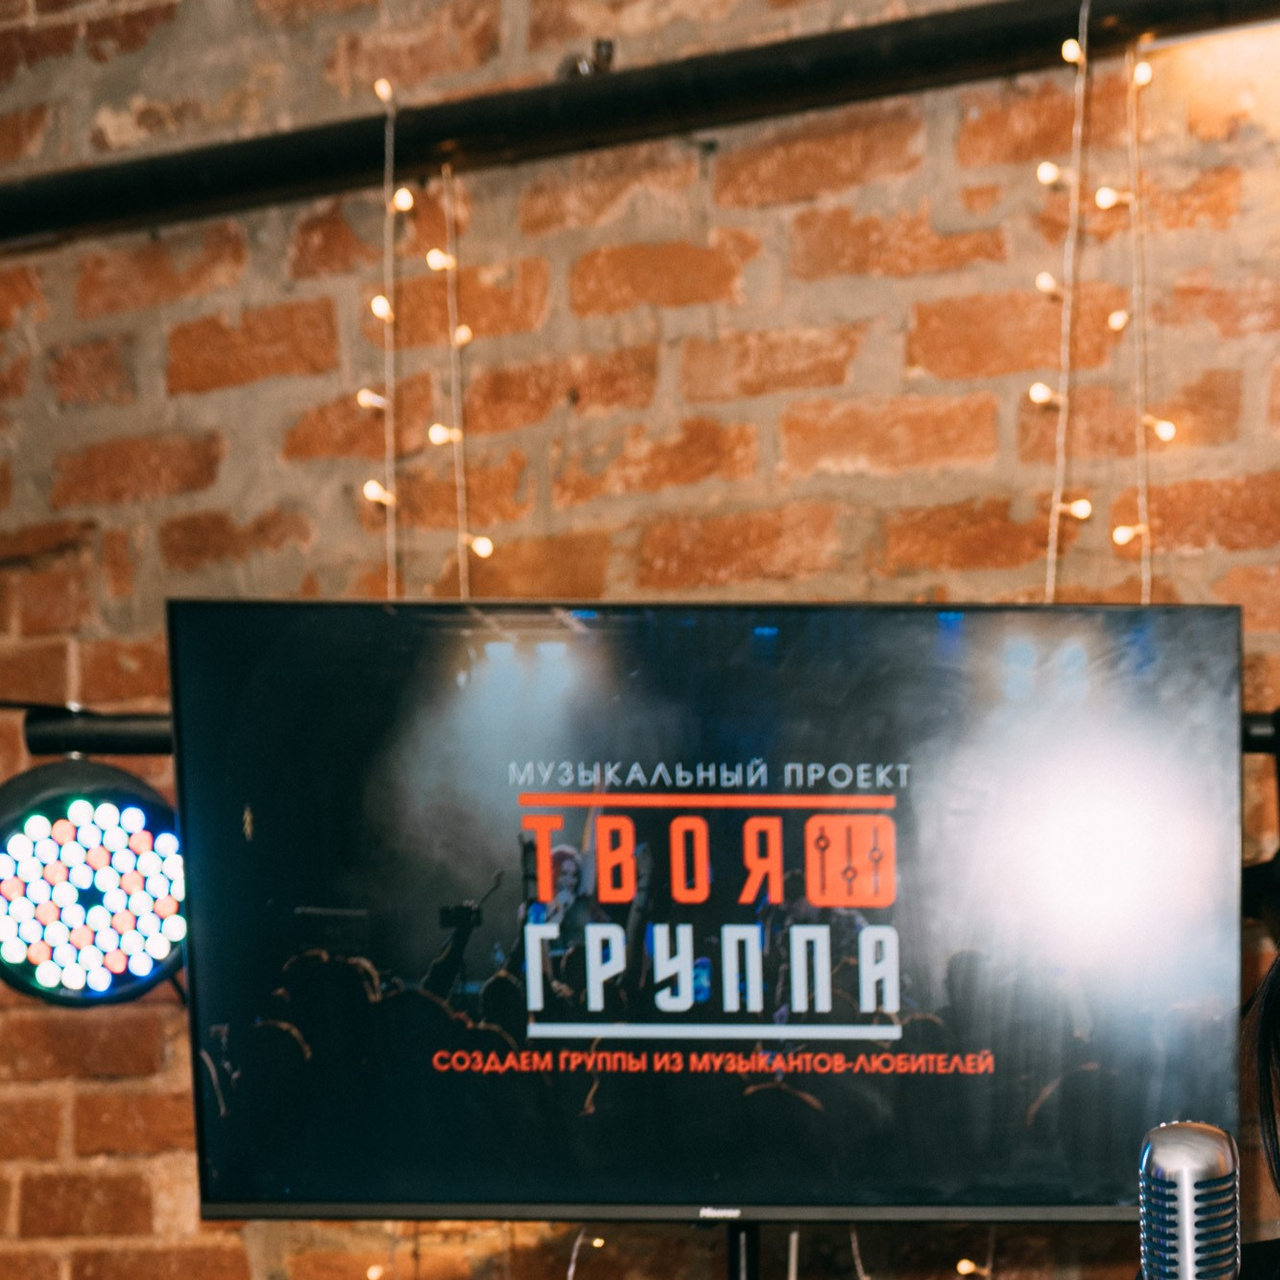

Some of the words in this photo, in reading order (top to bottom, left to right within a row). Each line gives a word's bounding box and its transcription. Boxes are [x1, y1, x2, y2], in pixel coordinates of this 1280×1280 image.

[508, 757, 768, 788] МУЗЫКАЛЬНЫЙ
[784, 761, 911, 789] ПРОЕКТ
[521, 814, 784, 905] ТВОЯ
[524, 923, 901, 1014] ГРУППА
[432, 1050, 553, 1075] СОЗДАЕМ
[559, 1051, 647, 1074] ГРУППЫ
[654, 1051, 684, 1073] ИЗ
[689, 1049, 995, 1075] МУЗЫКАНТОВ-ЛЮБИТЕЛЕЙ
